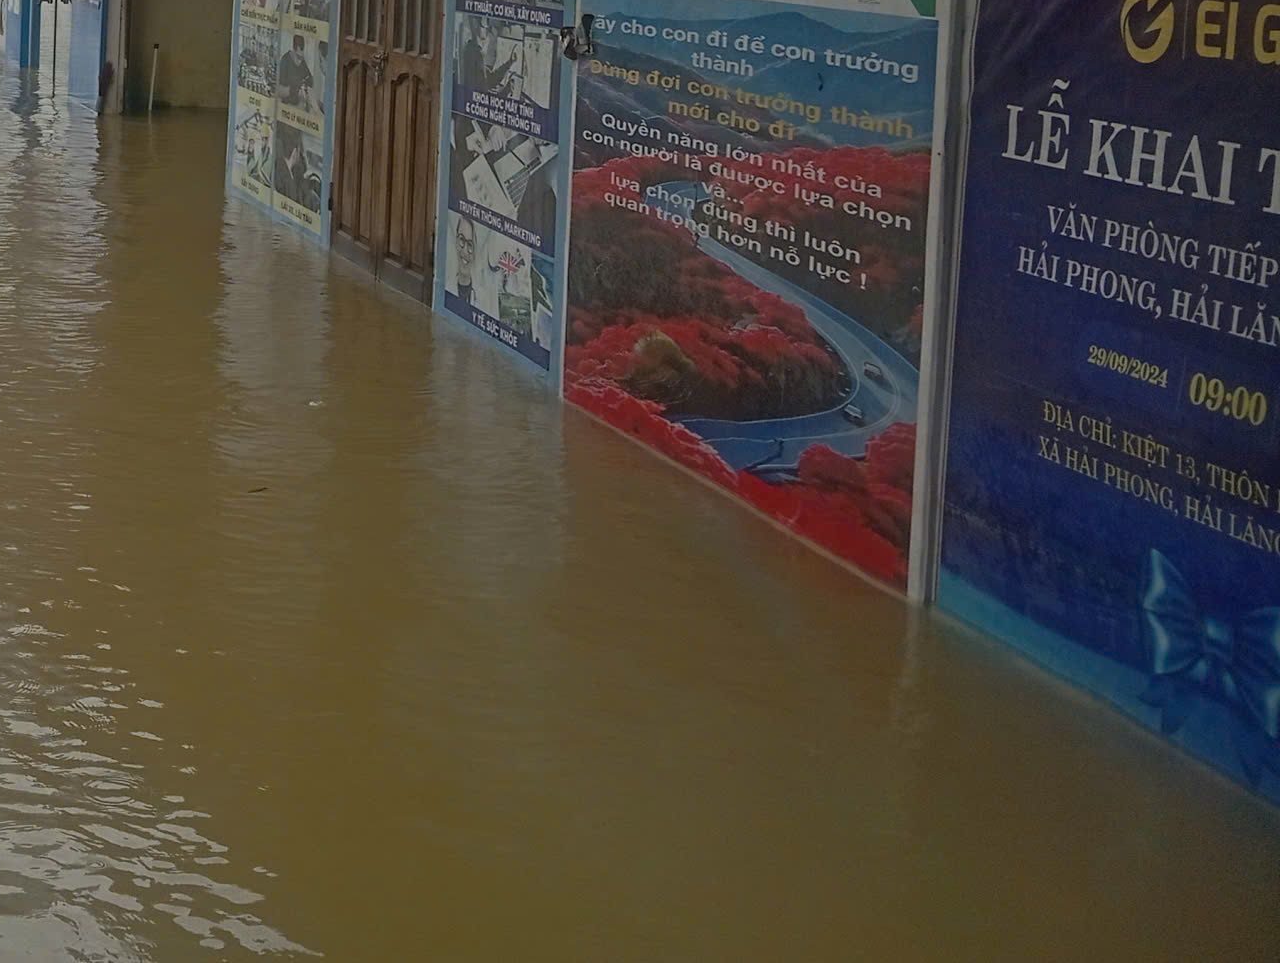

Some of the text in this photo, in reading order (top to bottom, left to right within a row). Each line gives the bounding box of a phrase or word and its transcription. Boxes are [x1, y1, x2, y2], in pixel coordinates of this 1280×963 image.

[530, 9, 551, 25] DỰNG
[1196, 0, 1239, 61] EI
[621, 21, 919, 83] cho con đi để con trưởng
[691, 51, 754, 77] thành
[590, 58, 913, 140] Đừng đợi con trưởng thành
[668, 98, 797, 141] mới cho đi
[601, 113, 882, 199] Quyền năng lớn nhất của
[1001, 78, 1241, 206] LỄ KHAI
[505, 222, 541, 248] MARKETING
[1047, 203, 1279, 289] VĂN PHÒNG TIẾP
[1016, 239, 1224, 333] HẢI PHONG, HẢI
[1086, 344, 1169, 390] 29/09/2024
[1188, 372, 1268, 428] 09:00
[1038, 434, 1061, 465] XÃ
[1064, 444, 1098, 482] HẢI
[1103, 462, 1179, 516] PHONG,
[1184, 494, 1224, 532] HẢI
[1042, 400, 1269, 509] ĐỊA CHỈ: KIỆT 13, THÔN
